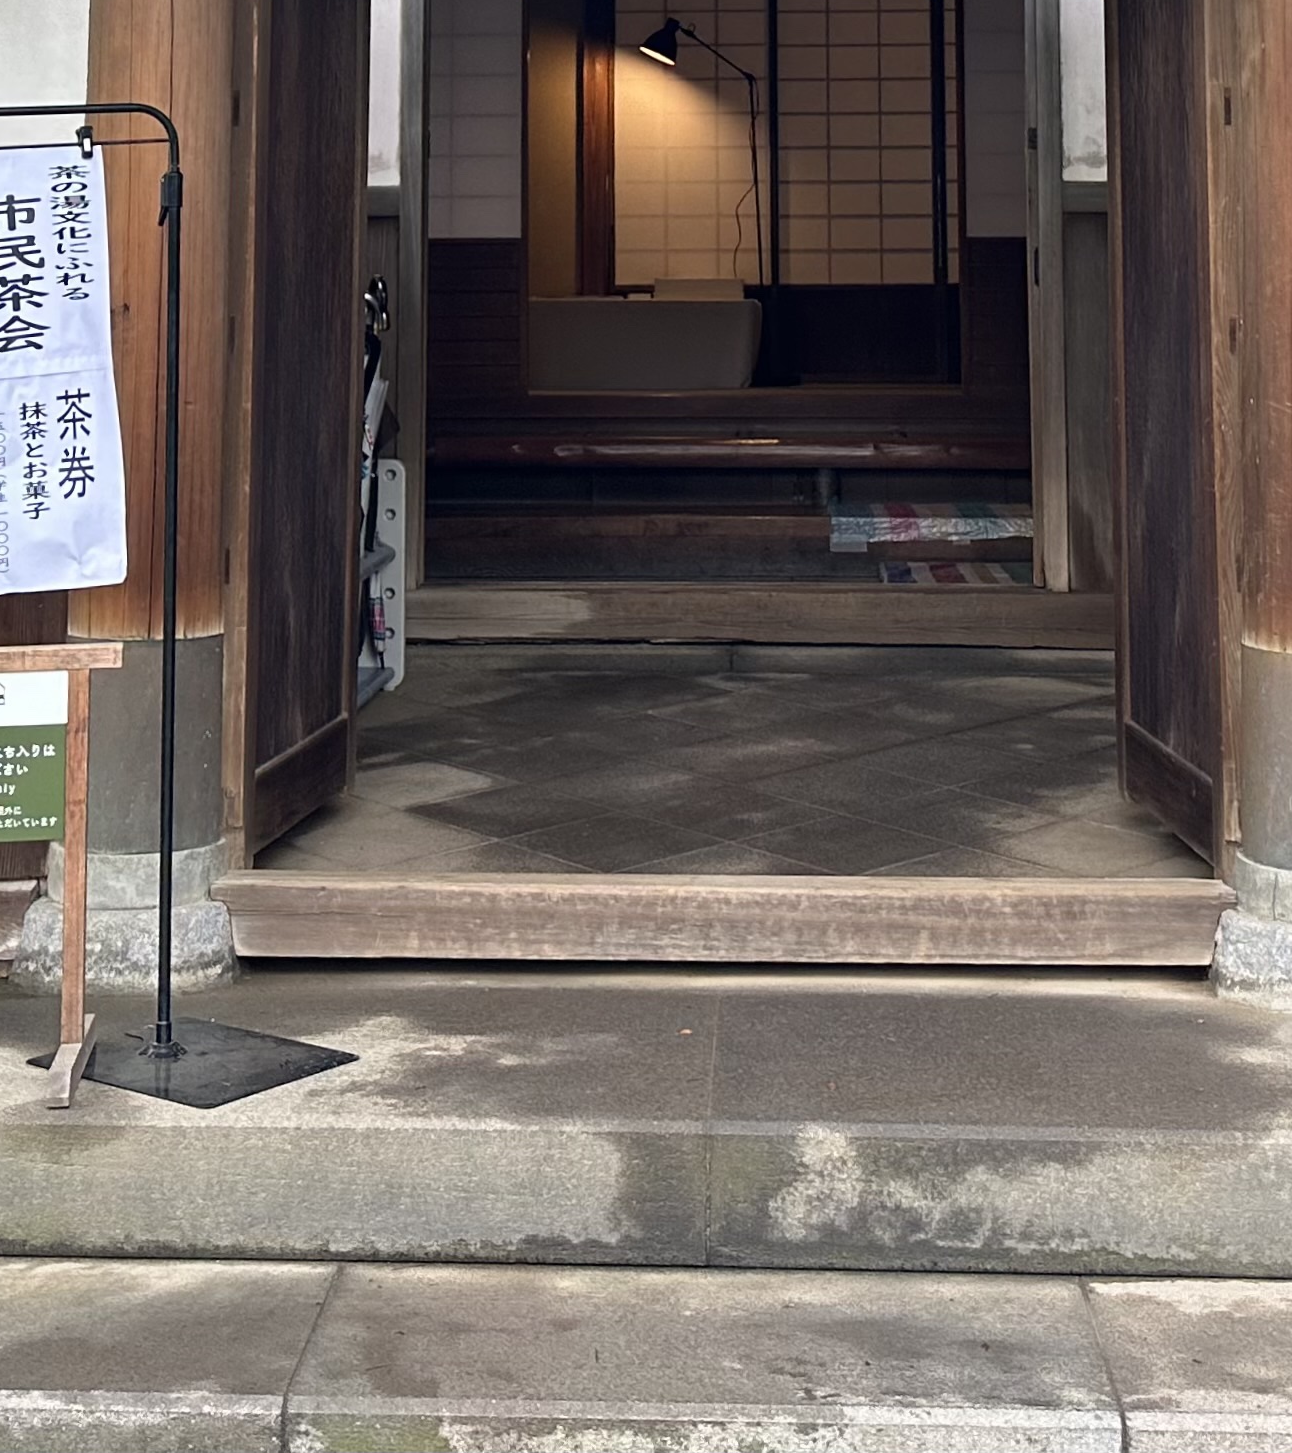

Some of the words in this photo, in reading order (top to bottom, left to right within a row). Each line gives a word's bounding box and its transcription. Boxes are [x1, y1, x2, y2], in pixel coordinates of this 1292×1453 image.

[48, 165, 94, 301] 茶の湯文化にふれる
[19, 402, 51, 520] 抹茶とお菓子
[56, 388, 95, 499] 茶券
